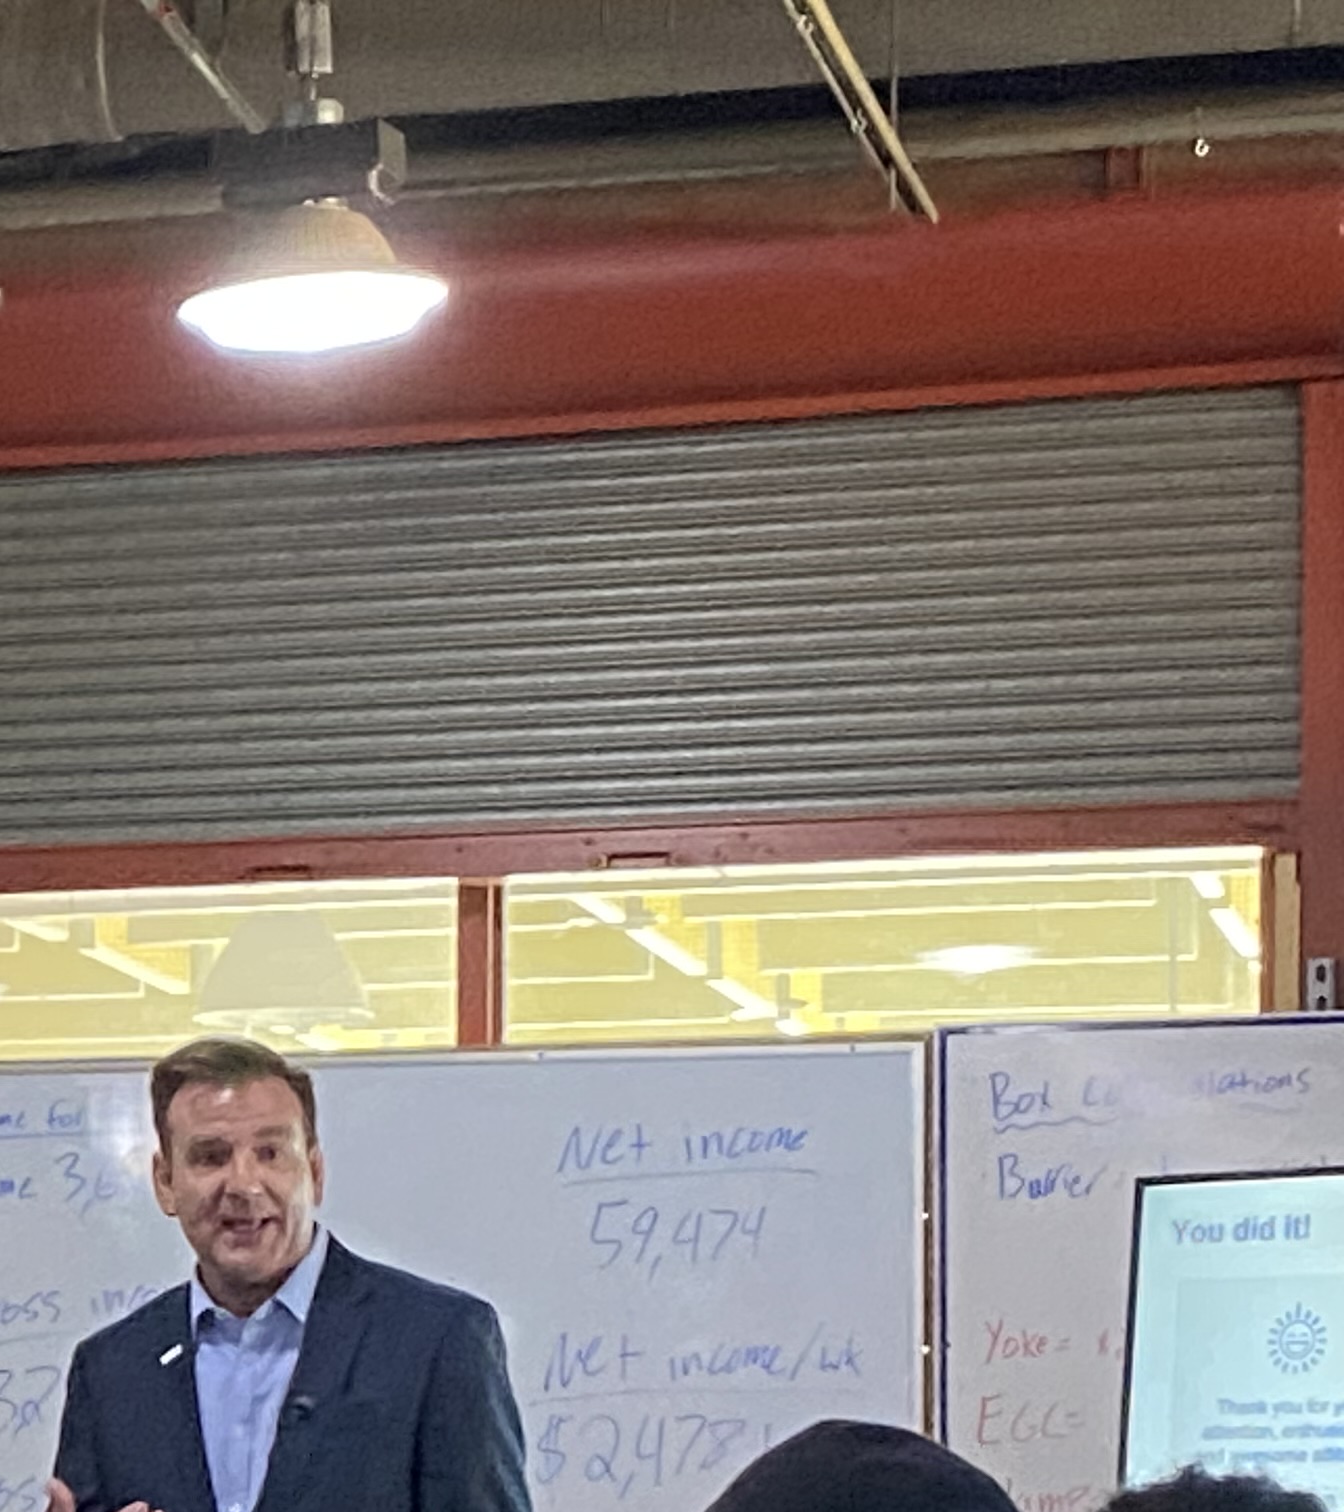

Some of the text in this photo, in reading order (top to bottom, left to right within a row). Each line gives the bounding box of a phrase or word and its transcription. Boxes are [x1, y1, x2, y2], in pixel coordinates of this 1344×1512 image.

[556, 1123, 651, 1174] Net
[590, 1200, 768, 1282] 59,474
[1172, 1218, 1224, 1245] You
[1233, 1215, 1276, 1243] did
[543, 1331, 645, 1392] Net
